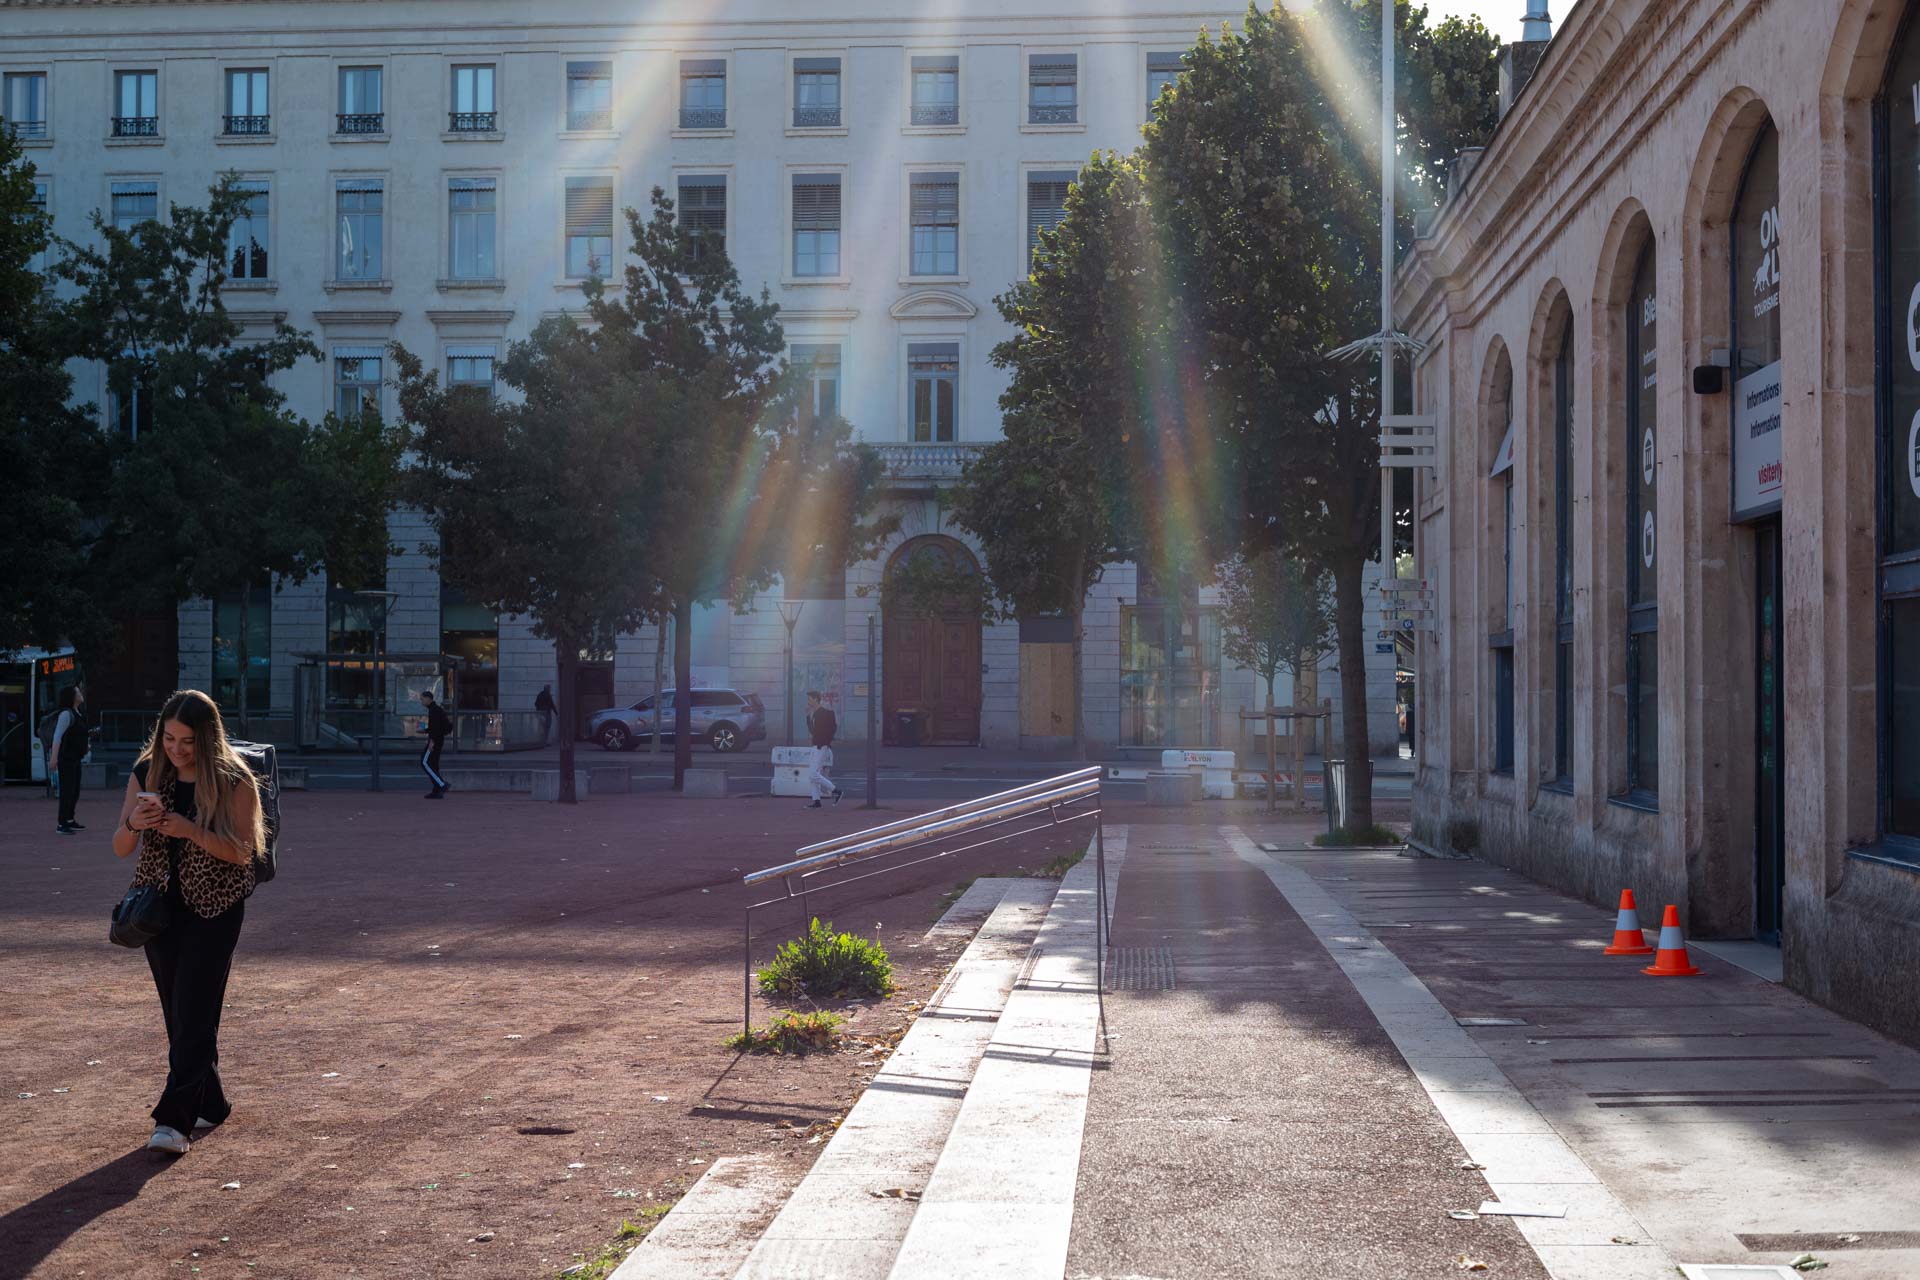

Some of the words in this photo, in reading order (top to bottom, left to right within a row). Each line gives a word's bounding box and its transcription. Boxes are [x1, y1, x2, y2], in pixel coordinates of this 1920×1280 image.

[1771, 246, 1780, 285] L
[1754, 292, 1778, 319] TOURISME
[1746, 382, 1780, 410] Informations
[1750, 413, 1781, 440] Information
